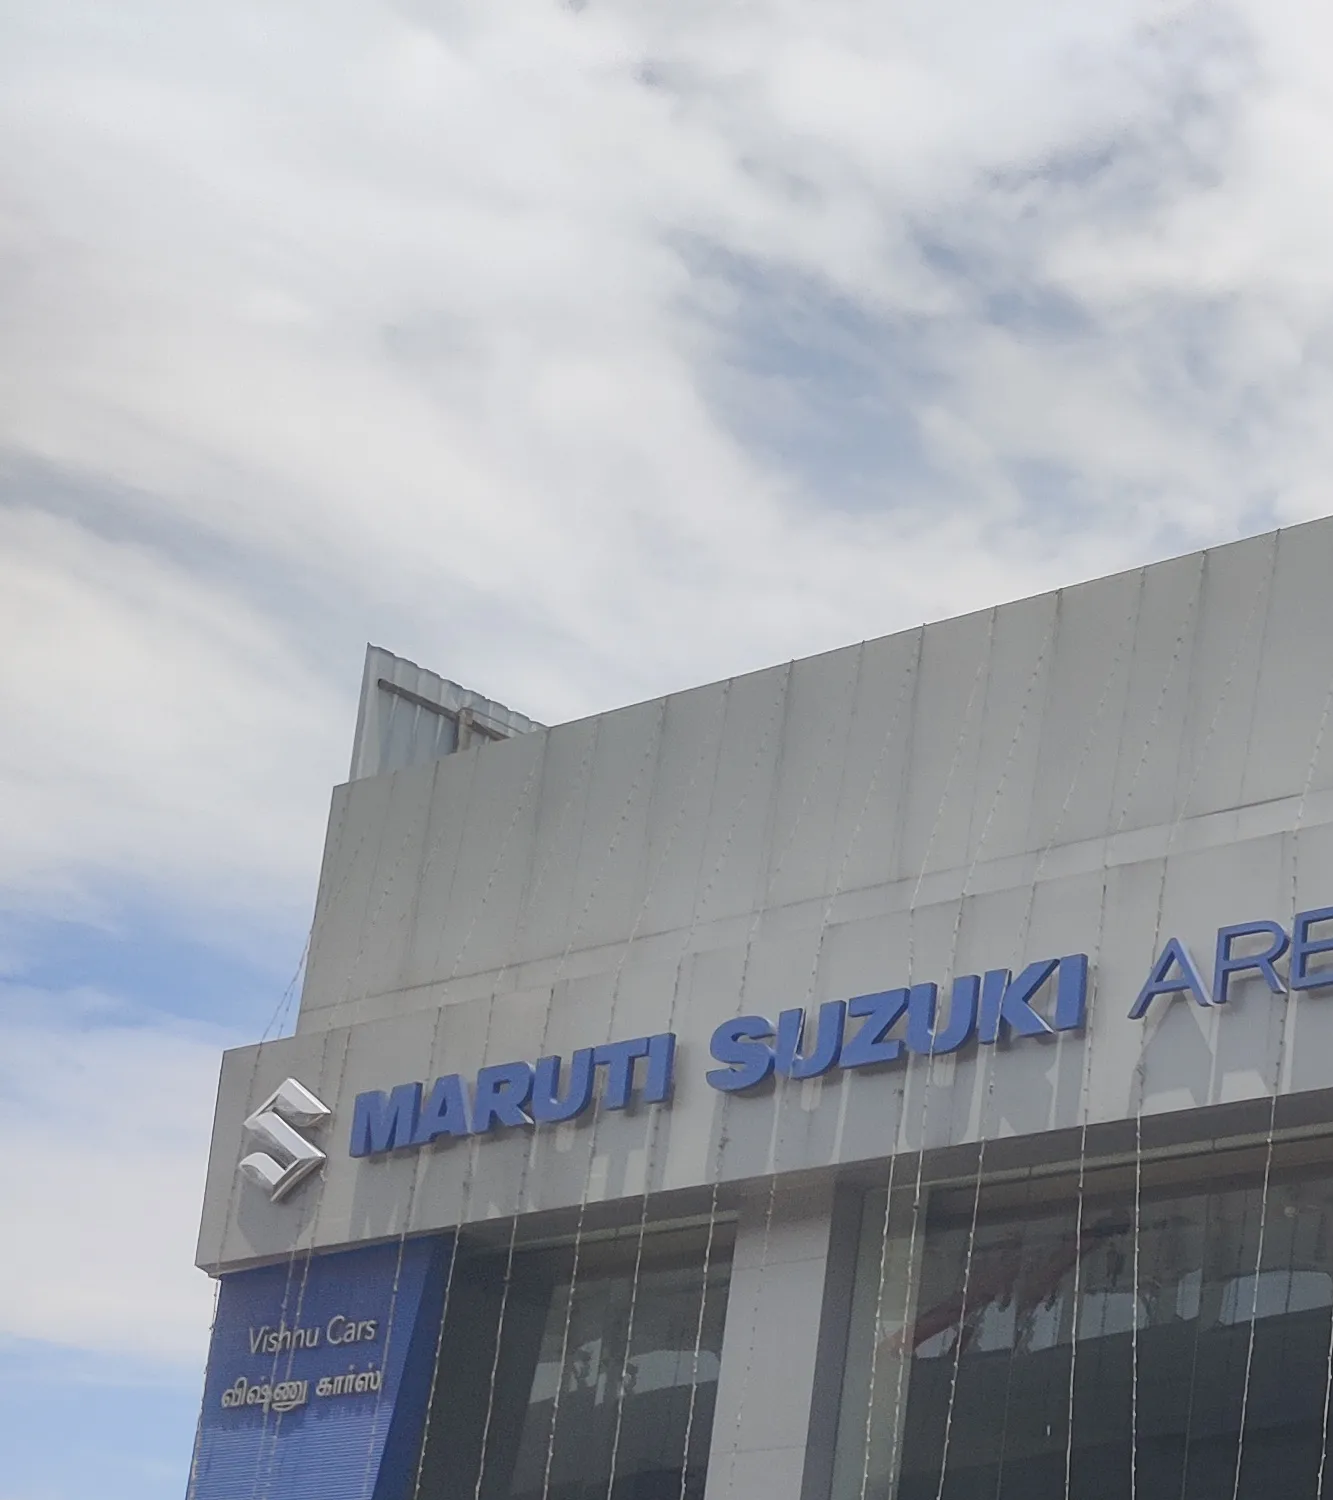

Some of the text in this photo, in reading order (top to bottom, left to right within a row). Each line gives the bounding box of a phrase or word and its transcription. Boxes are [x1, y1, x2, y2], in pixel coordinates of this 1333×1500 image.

[349, 1031, 677, 1159] MARUTI
[706, 953, 1089, 1093] SUZUKI
[249, 1315, 378, 1354] Vishnu Cars
